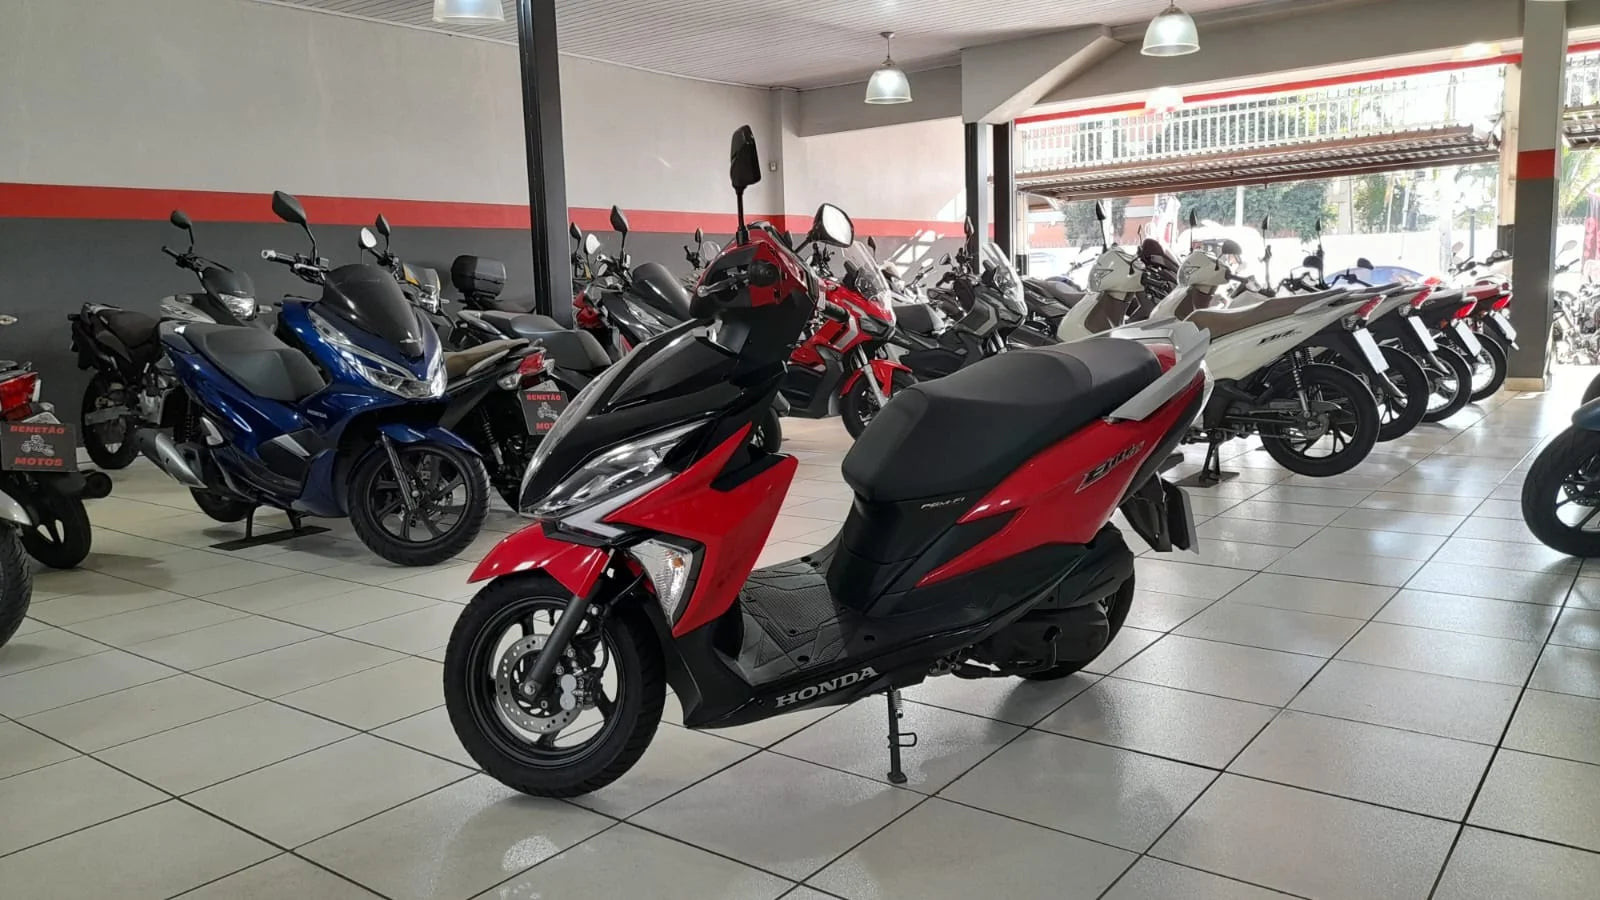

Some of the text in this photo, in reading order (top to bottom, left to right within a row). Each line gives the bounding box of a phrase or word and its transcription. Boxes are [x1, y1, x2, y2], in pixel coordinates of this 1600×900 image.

[10, 425, 65, 434] BENETÃO
[15, 456, 64, 467] MOTOS
[775, 666, 879, 708] HONDA
